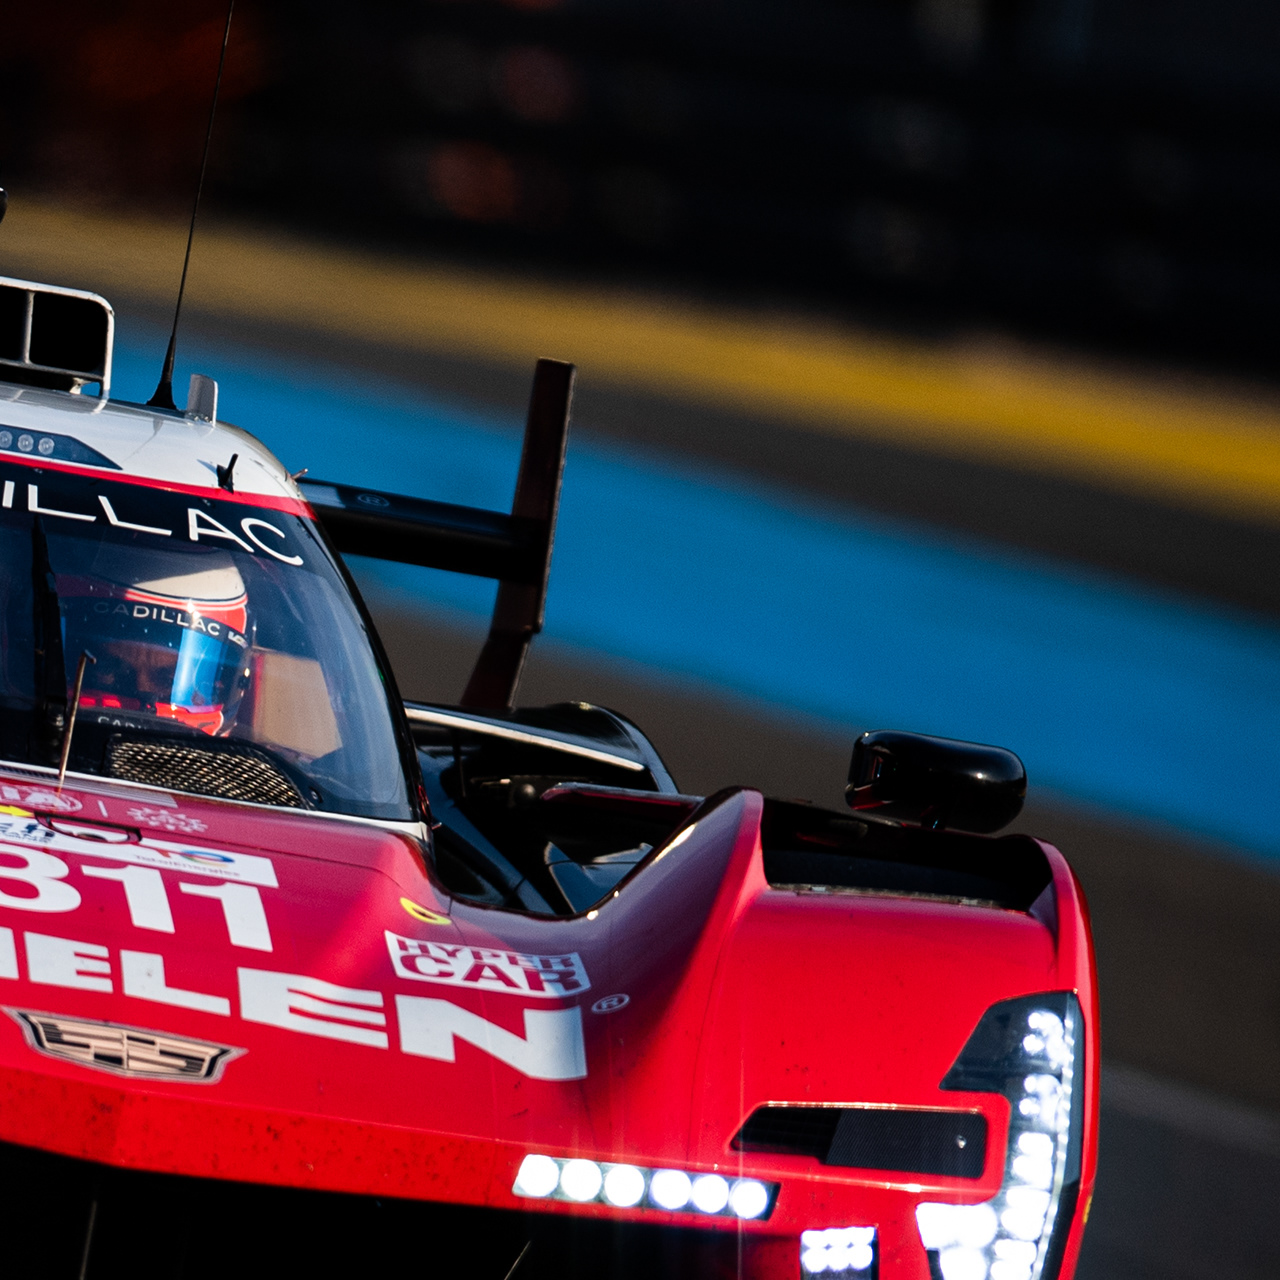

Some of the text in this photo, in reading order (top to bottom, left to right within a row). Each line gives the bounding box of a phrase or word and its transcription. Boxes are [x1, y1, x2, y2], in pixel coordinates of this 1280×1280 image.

[93, 601, 221, 637] CADILLAC
[395, 936, 574, 969] HYPER
[399, 954, 583, 993] CAR
